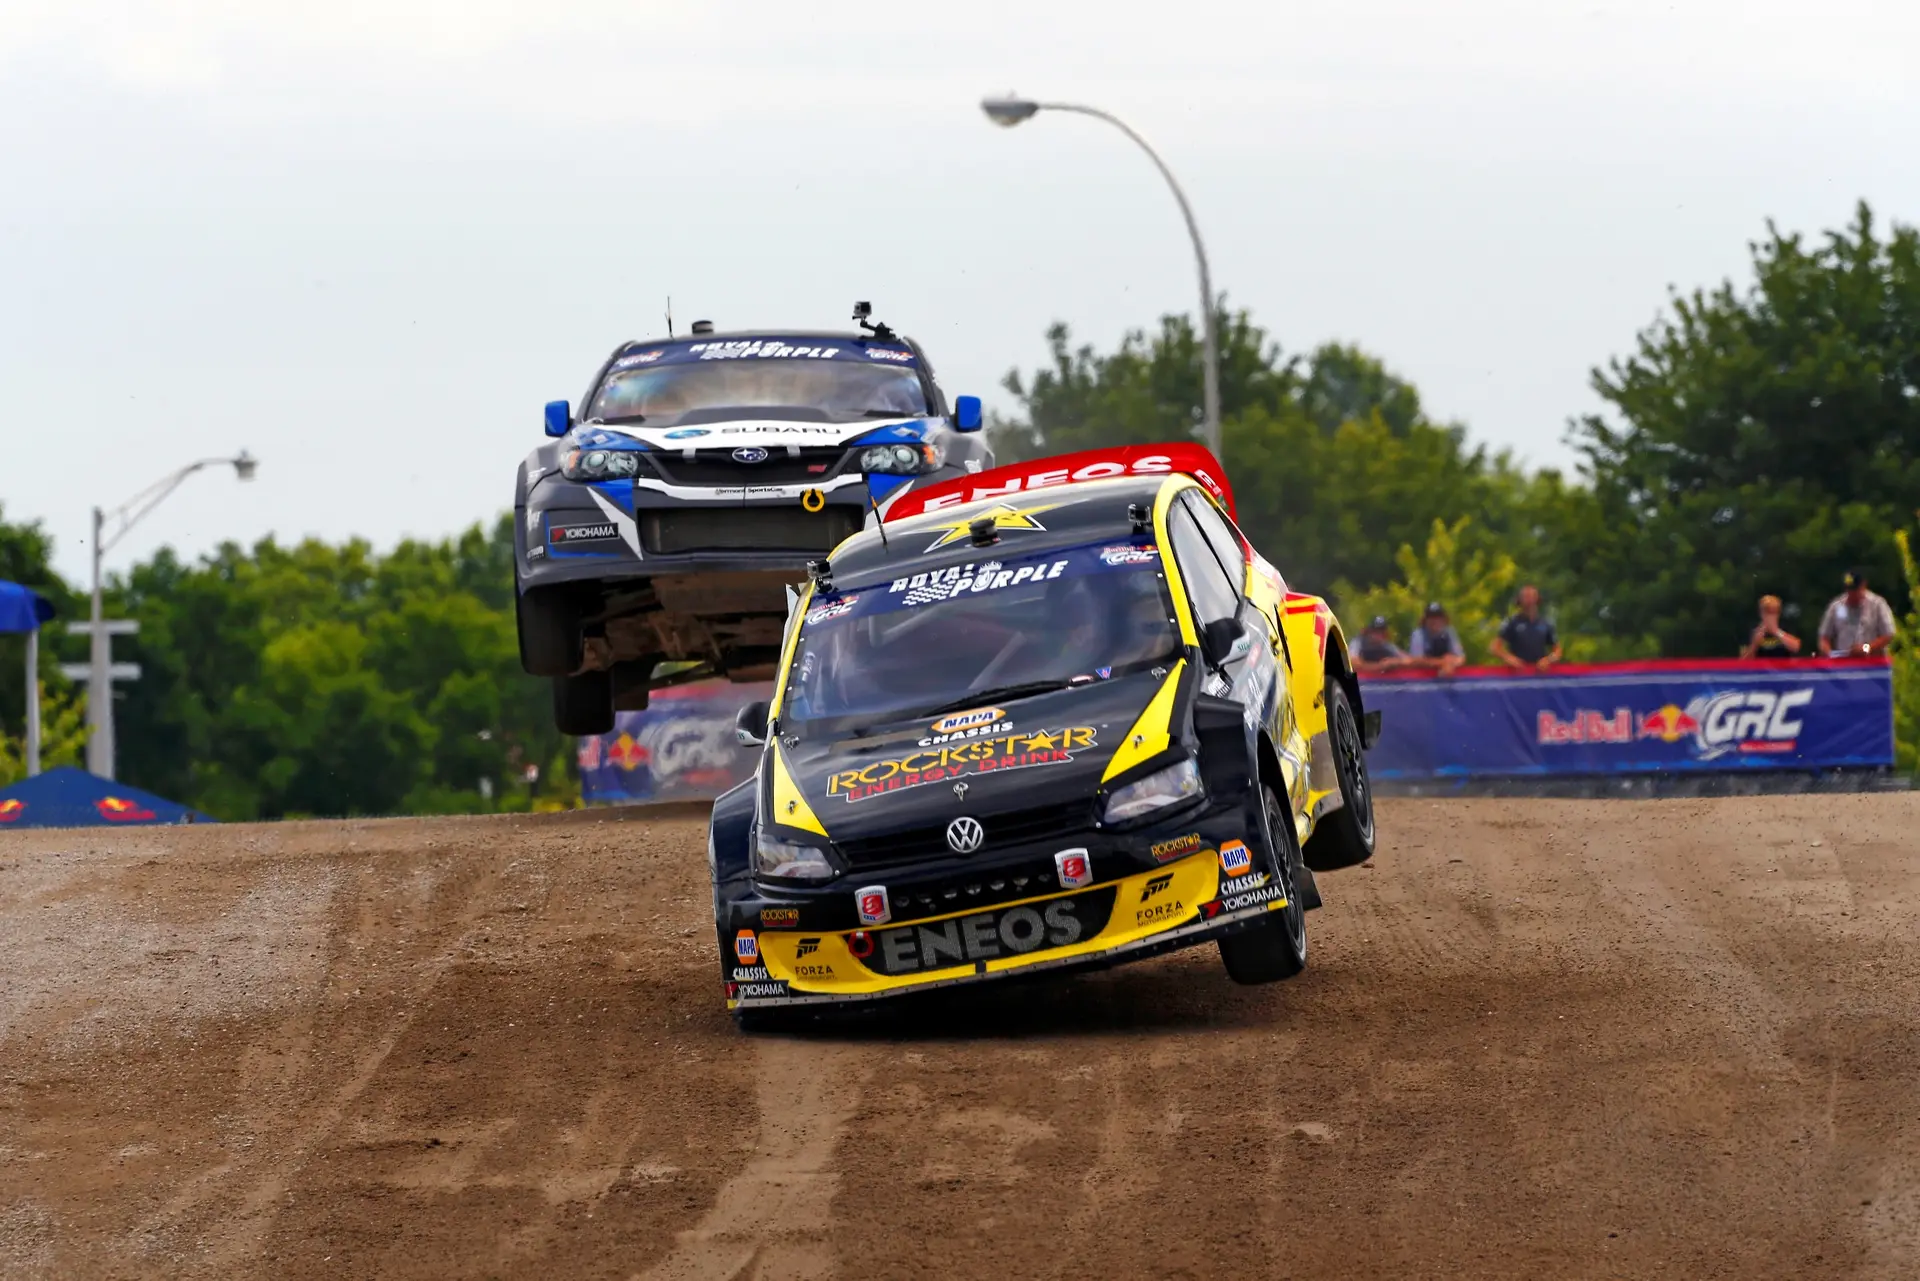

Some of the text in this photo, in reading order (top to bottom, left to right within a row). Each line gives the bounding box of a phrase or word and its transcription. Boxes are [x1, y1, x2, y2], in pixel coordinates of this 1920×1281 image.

[740, 345, 839, 358] PURPLE
[721, 426, 841, 434] SUBARU
[922, 455, 1173, 513] ENEOS
[565, 526, 615, 539] YOKOHAMA
[889, 563, 975, 593] ROYAL
[949, 560, 1069, 598] PURPLE
[943, 711, 995, 728] NAPA
[1538, 689, 1813, 744] Red Bull GRC
[918, 721, 1015, 747] CHASSIS
[830, 727, 1097, 793] ROCKSTAR
[849, 750, 1069, 800] ENERGY DRINK
[1222, 847, 1248, 868] NAPA
[1221, 871, 1265, 895] CHASSIS
[1136, 900, 1183, 920] FORZA
[1222, 886, 1282, 912] YOKOHAMA
[738, 939, 756, 955] NAPA
[880, 899, 1083, 973] ENEOS
[732, 966, 768, 980] CHASSIS
[795, 965, 834, 976] FORZA
[738, 984, 784, 996] YOKOHAMA
